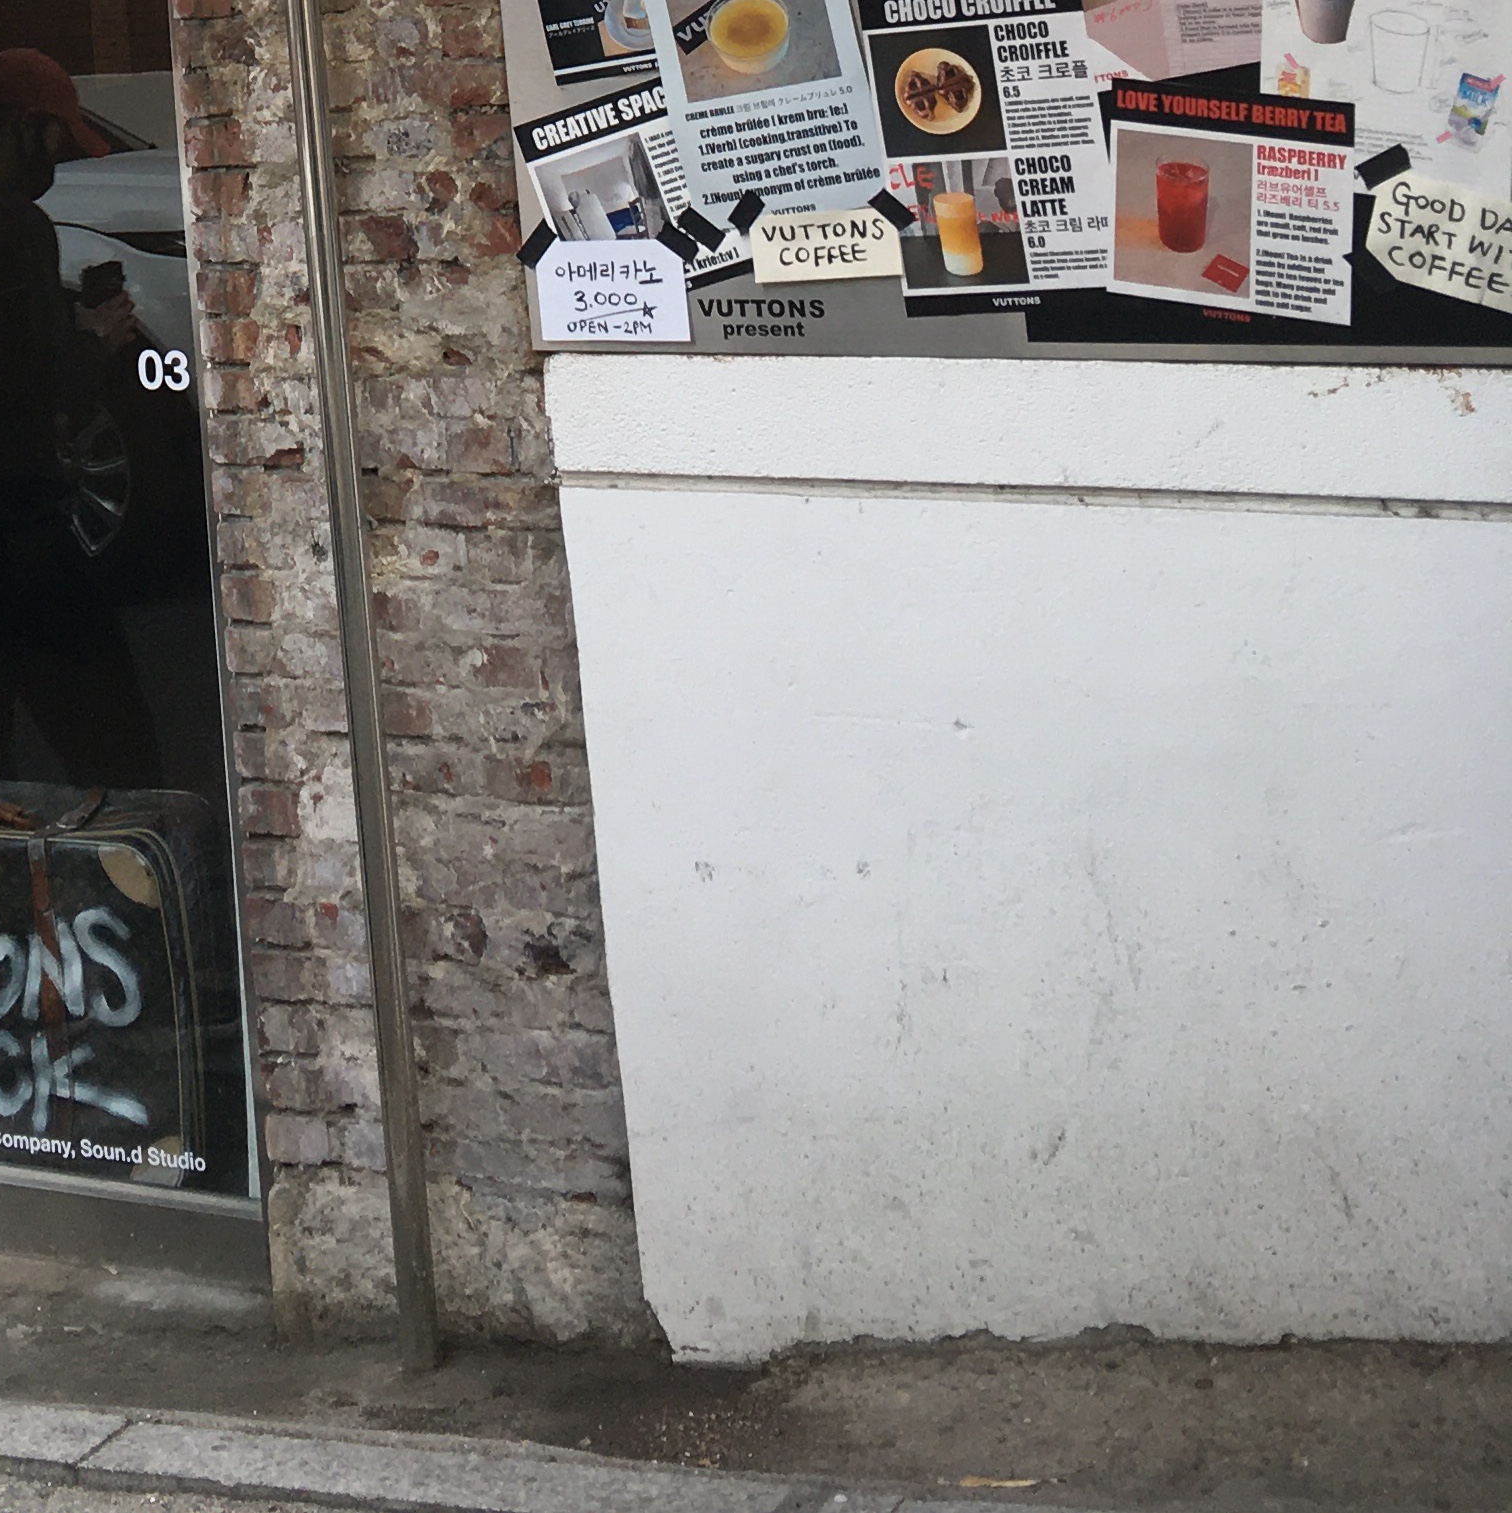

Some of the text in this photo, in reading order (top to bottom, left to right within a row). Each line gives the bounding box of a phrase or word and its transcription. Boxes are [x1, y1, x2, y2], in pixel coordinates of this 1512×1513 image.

[993, 21, 1050, 42] CHOCO
[997, 40, 1069, 63] CROIFFLE
[1000, 60, 1088, 83] 초코 크로플
[839, 86, 853, 95] 5.0
[1003, 85, 1021, 99] 6.5
[531, 86, 667, 151] CREATIVE SPAC
[778, 110, 806, 127] krem
[1117, 89, 1347, 134] LOVE YOURSELF BERRY TEA
[845, 120, 858, 130] To
[701, 142, 827, 173] create sugary crust on
[1014, 155, 1072, 176] CHOCO
[1257, 144, 1347, 170] RASPBERRY
[732, 157, 839, 185] using chef's torch.
[795, 166, 881, 190] of crème brûlée
[1018, 176, 1075, 197] CREAM
[1257, 179, 1327, 198] 러브유어셀프
[771, 203, 816, 216] VUTTONS
[1021, 198, 1068, 218] LATTE
[1256, 192, 1340, 212] 라즈베리 티 5.5
[1392, 181, 1512, 234] GOOD DA
[761, 219, 885, 242] VUTTONS
[1025, 219, 1052, 234] 초코
[1056, 217, 1083, 232] 크림
[1027, 235, 1046, 249] 6.0
[1378, 211, 1512, 264] START WI
[779, 243, 867, 267] COFFEE
[555, 259, 663, 284] 아메리카노
[1388, 246, 1510, 294] COFFEE
[574, 291, 638, 312] 3.000
[697, 298, 825, 318] VUTTONS
[993, 296, 1041, 307] VUTTONS
[1202, 308, 1251, 323] VUTTONS
[723, 321, 805, 339] present
[138, 349, 190, 391] 03
[80, 1139, 142, 1164] Soun.d
[147, 1148, 206, 1172] Studio
